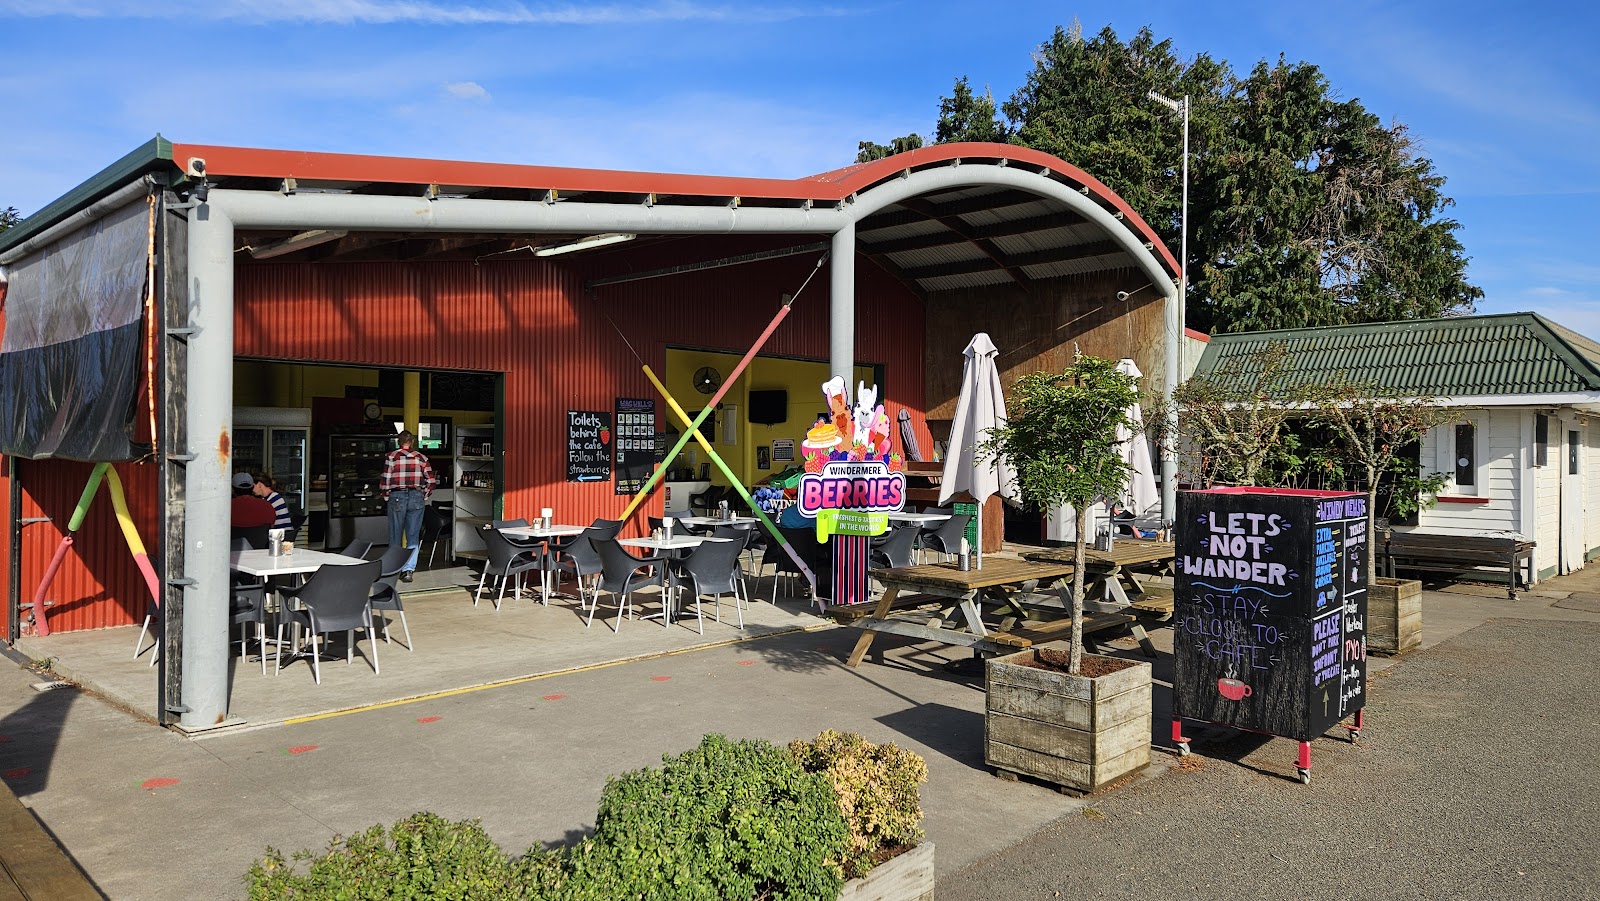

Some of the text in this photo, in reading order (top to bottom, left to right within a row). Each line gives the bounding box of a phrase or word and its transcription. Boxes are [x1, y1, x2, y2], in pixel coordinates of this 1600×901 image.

[568, 411, 601, 428] Toilets
[569, 426, 597, 438] behind
[568, 438, 602, 450] the cafe
[569, 450, 610, 462] Follow the
[829, 466, 882, 476] WINDERMERE
[803, 477, 903, 510] BERRIES
[832, 513, 857, 523] FRESHEST
[1320, 500, 1344, 521] WINDY
[839, 521, 880, 532] IN THE WORLD
[1208, 511, 1282, 536] LETS
[1316, 527, 1333, 543] EXTRA
[1209, 534, 1266, 559] NOT
[1183, 555, 1287, 586] WANDER
[1203, 593, 1261, 619] STAY
[1252, 623, 1278, 644] TO
[1313, 613, 1340, 641] PLEASE
[1327, 634, 1340, 648] PARK
[1345, 639, 1360, 661] PYO
[1206, 640, 1269, 669] CAFE
[1314, 671, 1321, 686] OF
